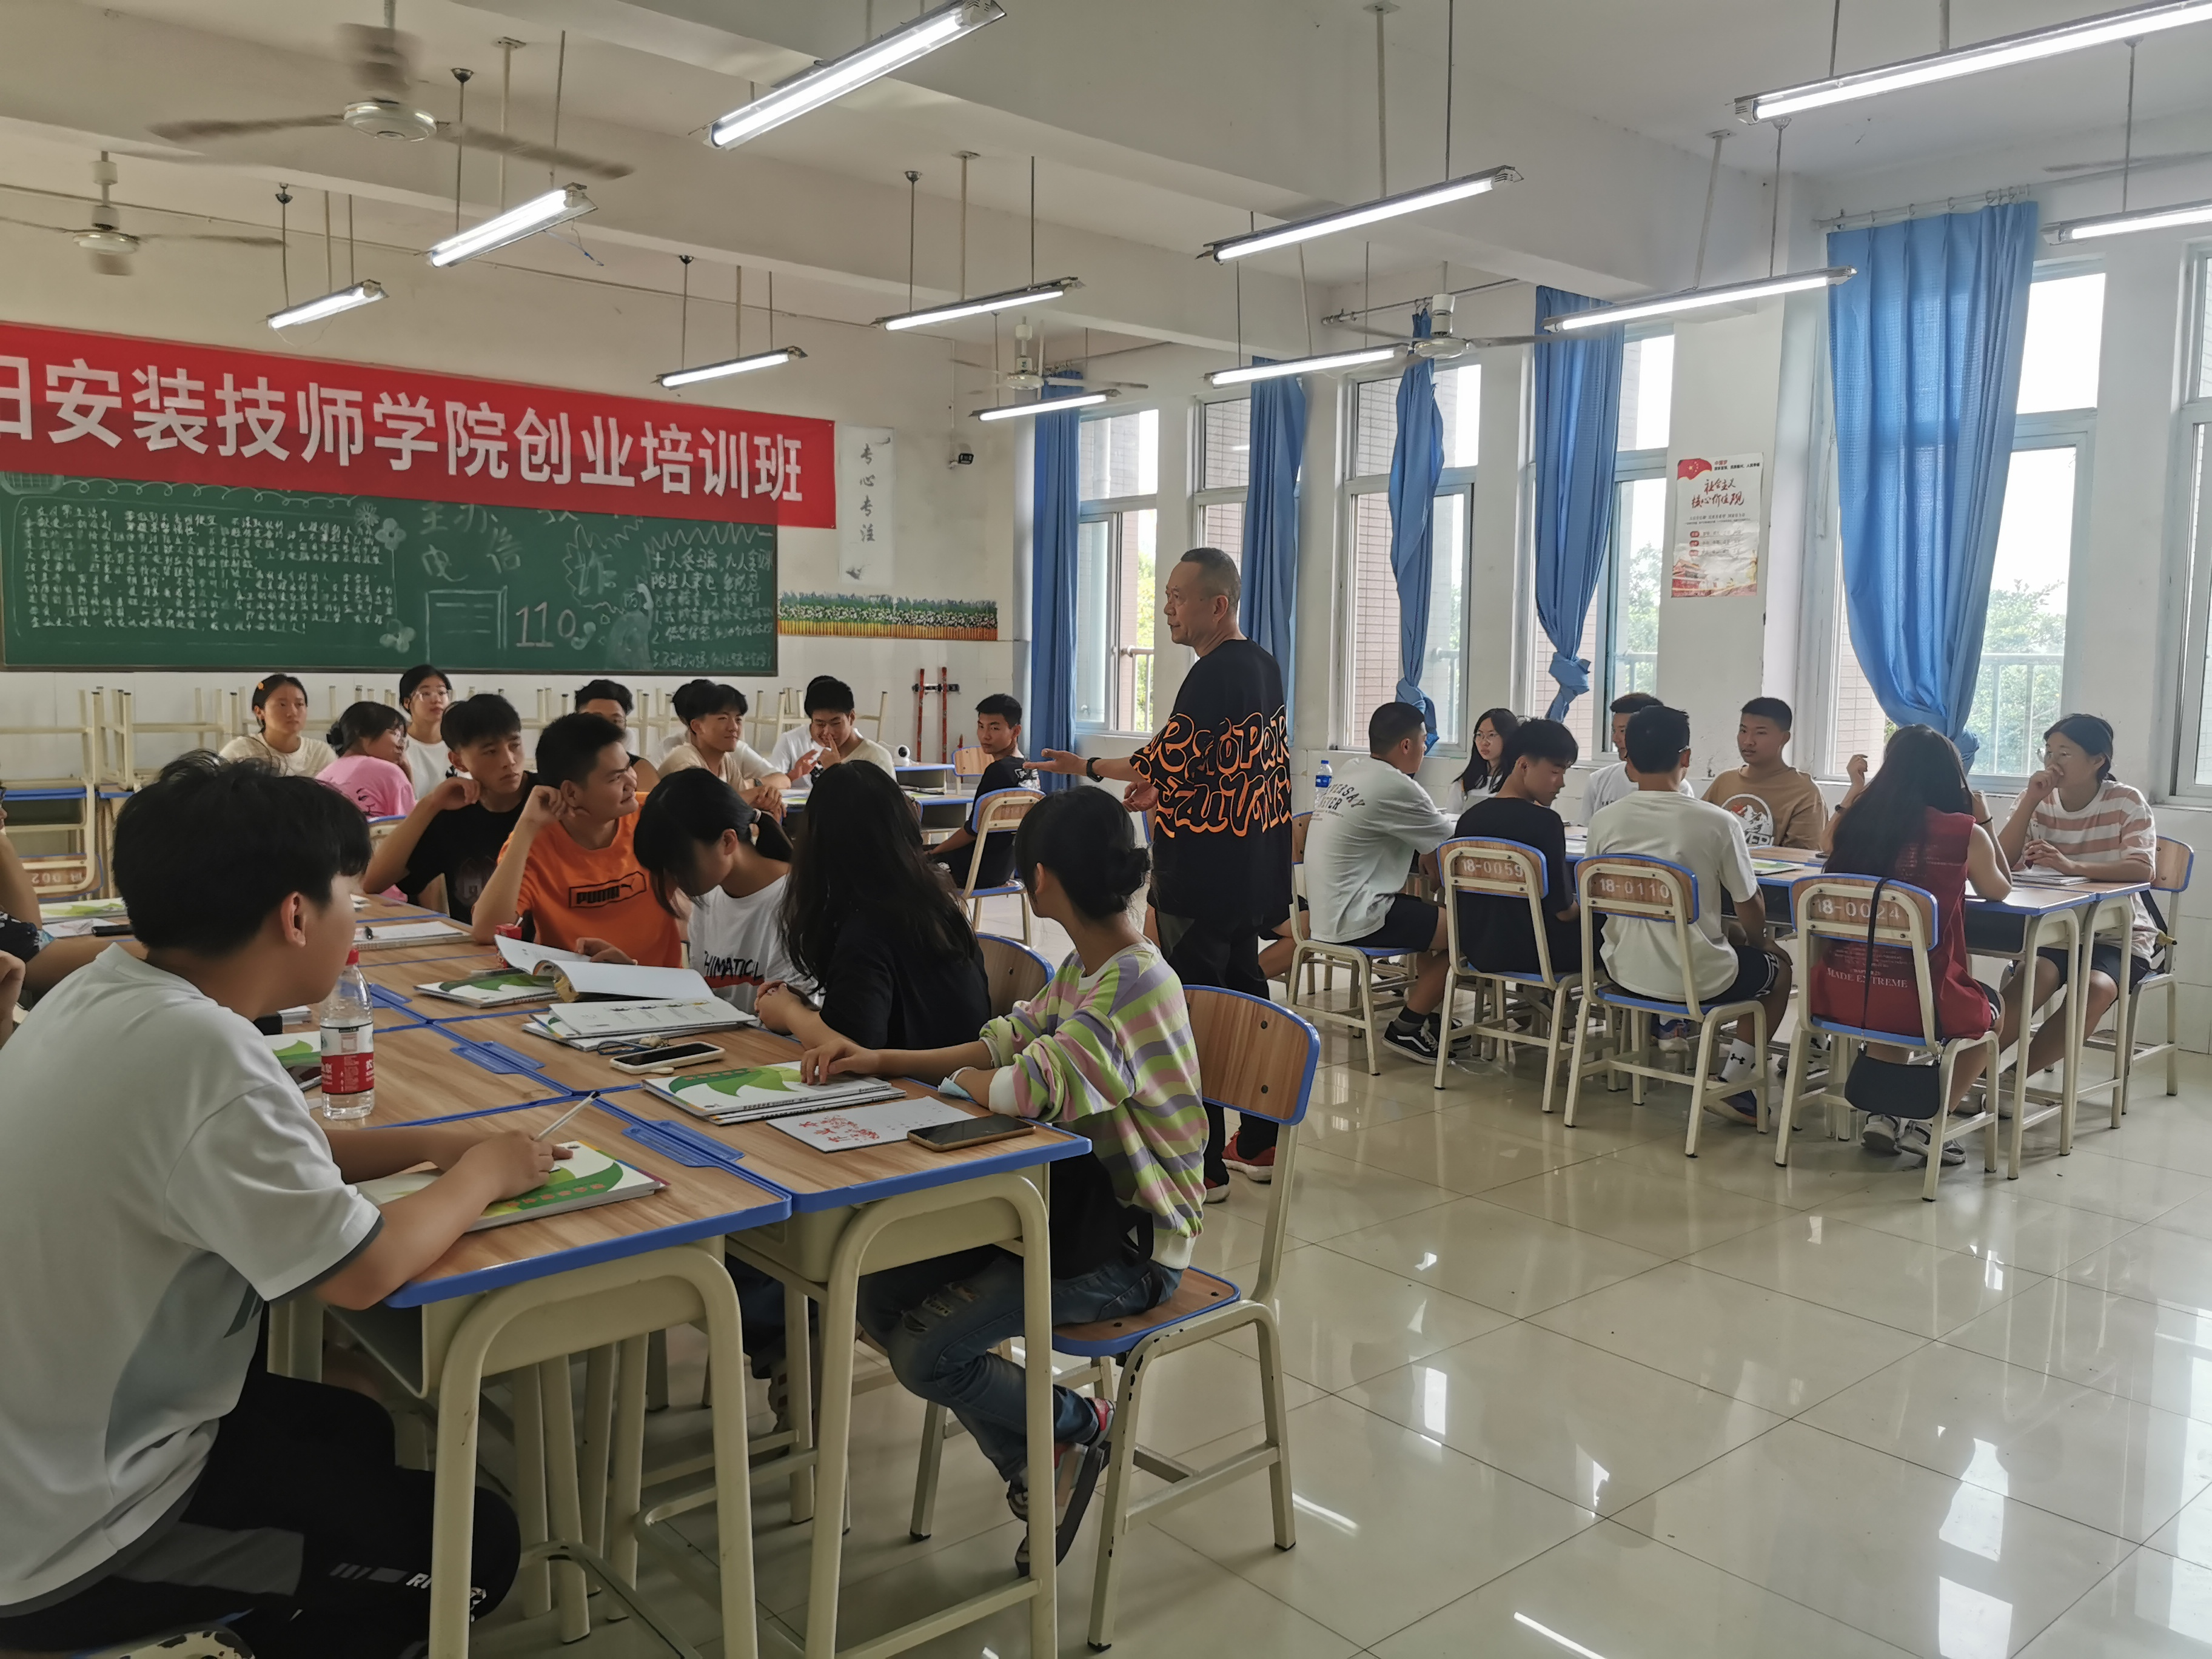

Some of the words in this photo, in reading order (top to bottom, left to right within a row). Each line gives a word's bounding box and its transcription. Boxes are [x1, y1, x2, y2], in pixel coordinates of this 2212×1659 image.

[859, 443, 876, 543] 专心专注
[1704, 478, 1736, 494] 社会主义
[1692, 491, 1744, 509] 核心价值观
[515, 602, 576, 648] 110
[1461, 859, 1524, 877] 18-0059
[577, 885, 620, 904] PUMA
[1600, 878, 1670, 899] 18-0110
[1815, 899, 1900, 920] 18-0024
[1826, 967, 1854, 981] MADE
